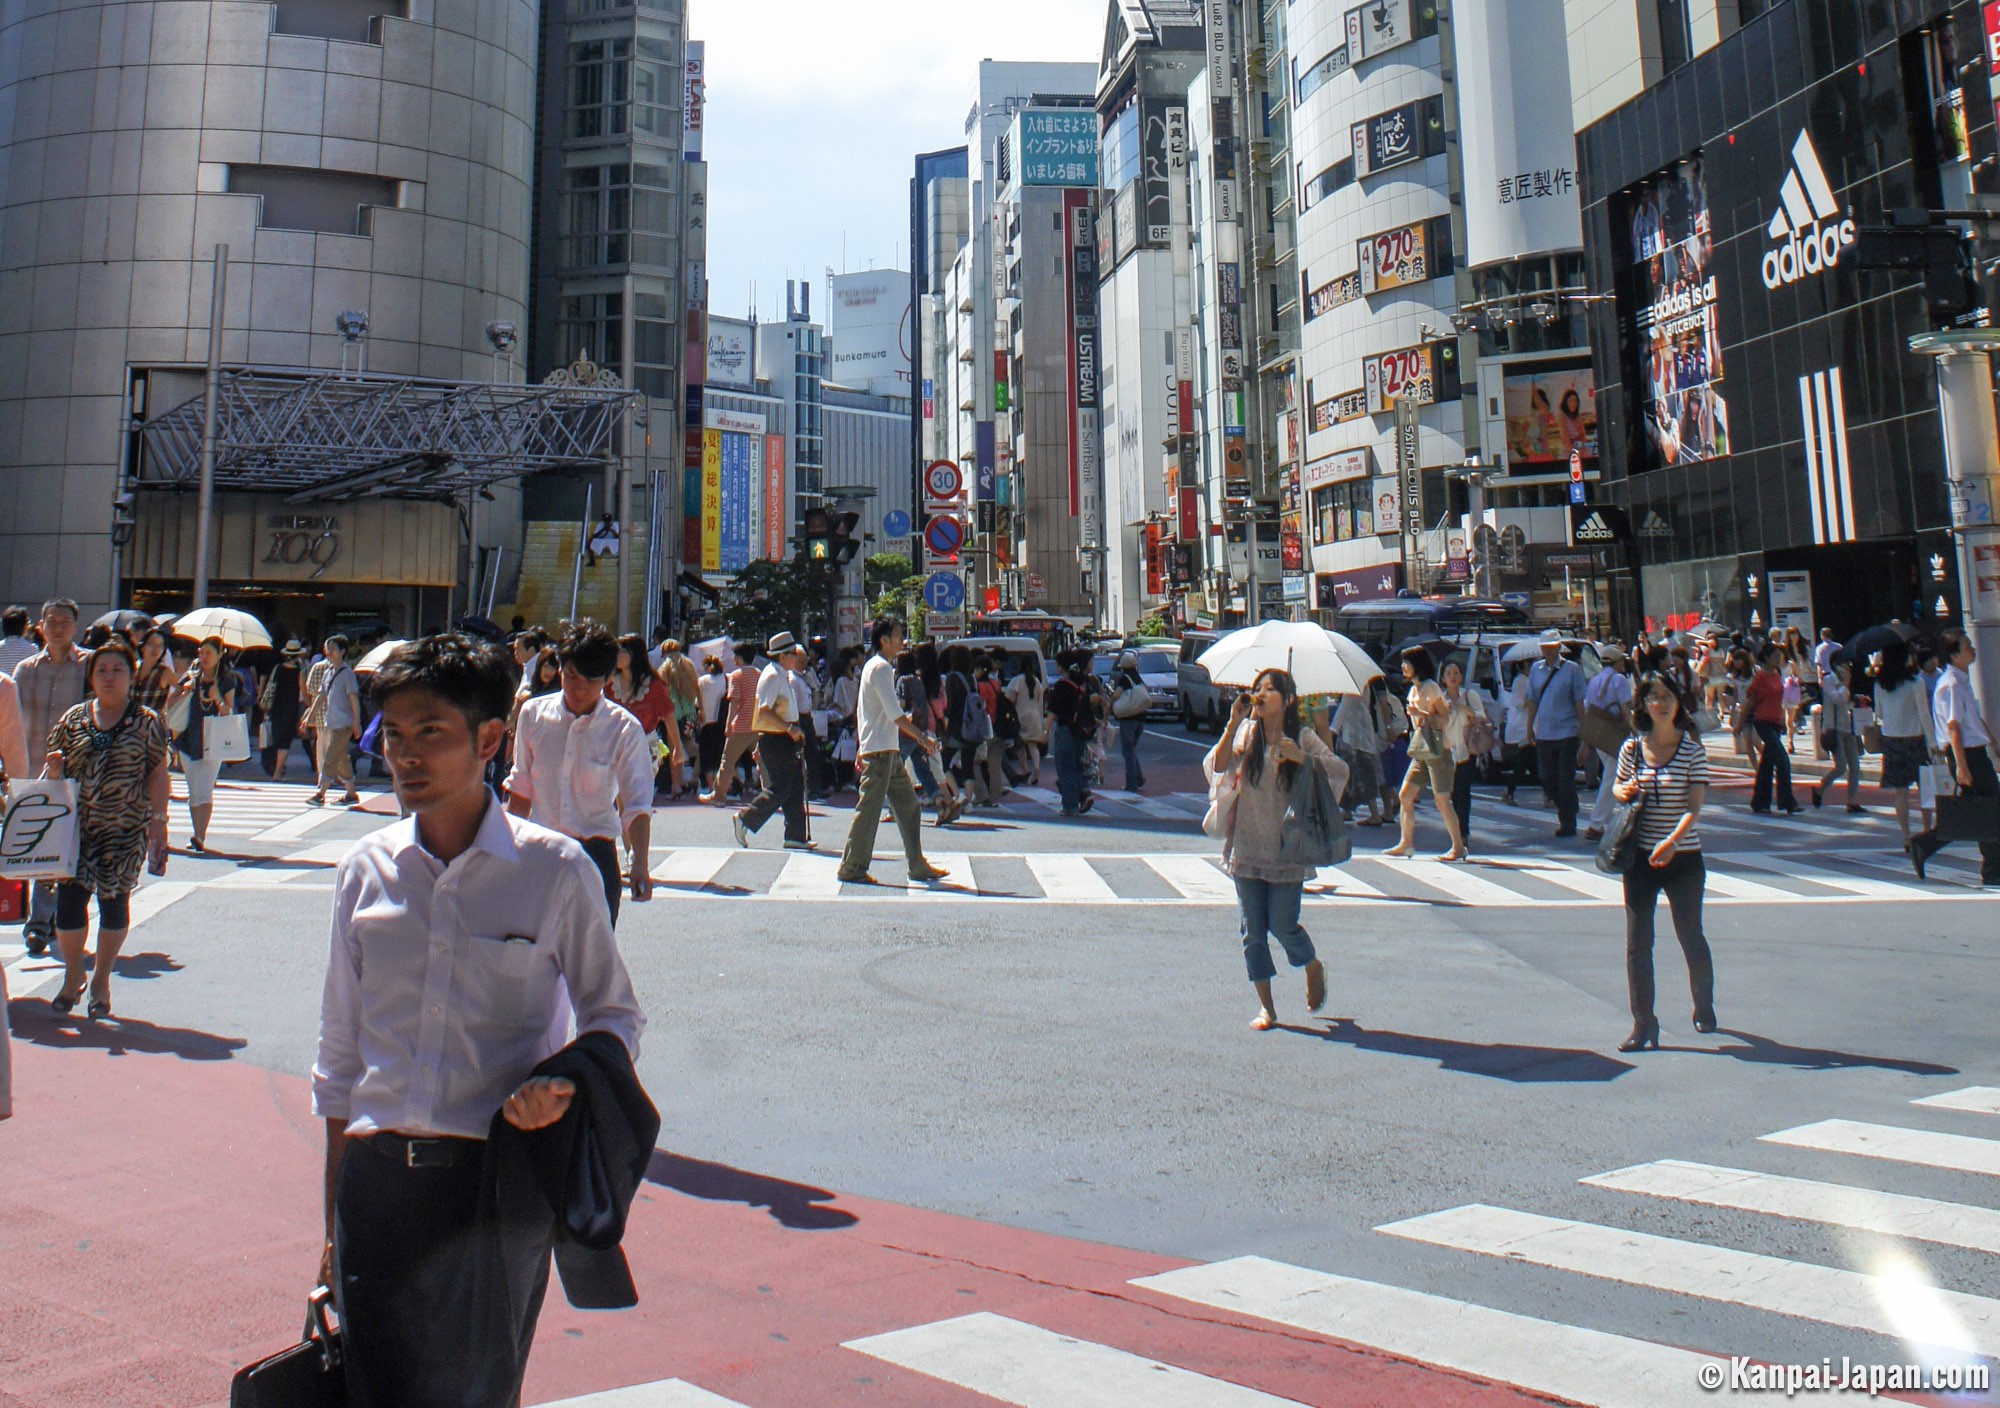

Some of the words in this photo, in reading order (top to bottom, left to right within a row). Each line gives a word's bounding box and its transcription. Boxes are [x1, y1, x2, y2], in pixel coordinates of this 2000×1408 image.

[1212, 3, 1223, 27] Lu82
[1214, 32, 1224, 52] BLD
[1215, 56, 1221, 65] by
[1215, 65, 1223, 89] COAST
[690, 79, 702, 131] LABI
[1027, 116, 1097, 133] 入れ歯にさような
[1027, 162, 1087, 180] いましろ歯科
[1377, 228, 1413, 275] 270
[1762, 219, 1856, 289] adidas
[1321, 283, 1334, 312] 270
[1654, 287, 1691, 320] adidas
[1691, 283, 1703, 306] is
[1703, 275, 1718, 302] all
[835, 349, 887, 362] Bunkamura
[1079, 335, 1093, 402] USTREAM
[1383, 349, 1420, 394] 270
[1405, 425, 1416, 462] SAINT
[1082, 431, 1094, 484] SoftBank
[706, 431, 722, 532] 夏の総決算
[933, 471, 955, 489] 30
[1407, 467, 1419, 507] LOUIS
[1409, 510, 1421, 536] BLD
[1576, 528, 1614, 539] adidas
[260, 531, 342, 579] 109
[933, 582, 949, 608] P
[944, 595, 956, 608] 40
[6, 856, 33, 865] TOKYU
[34, 855, 61, 864] HANDS
